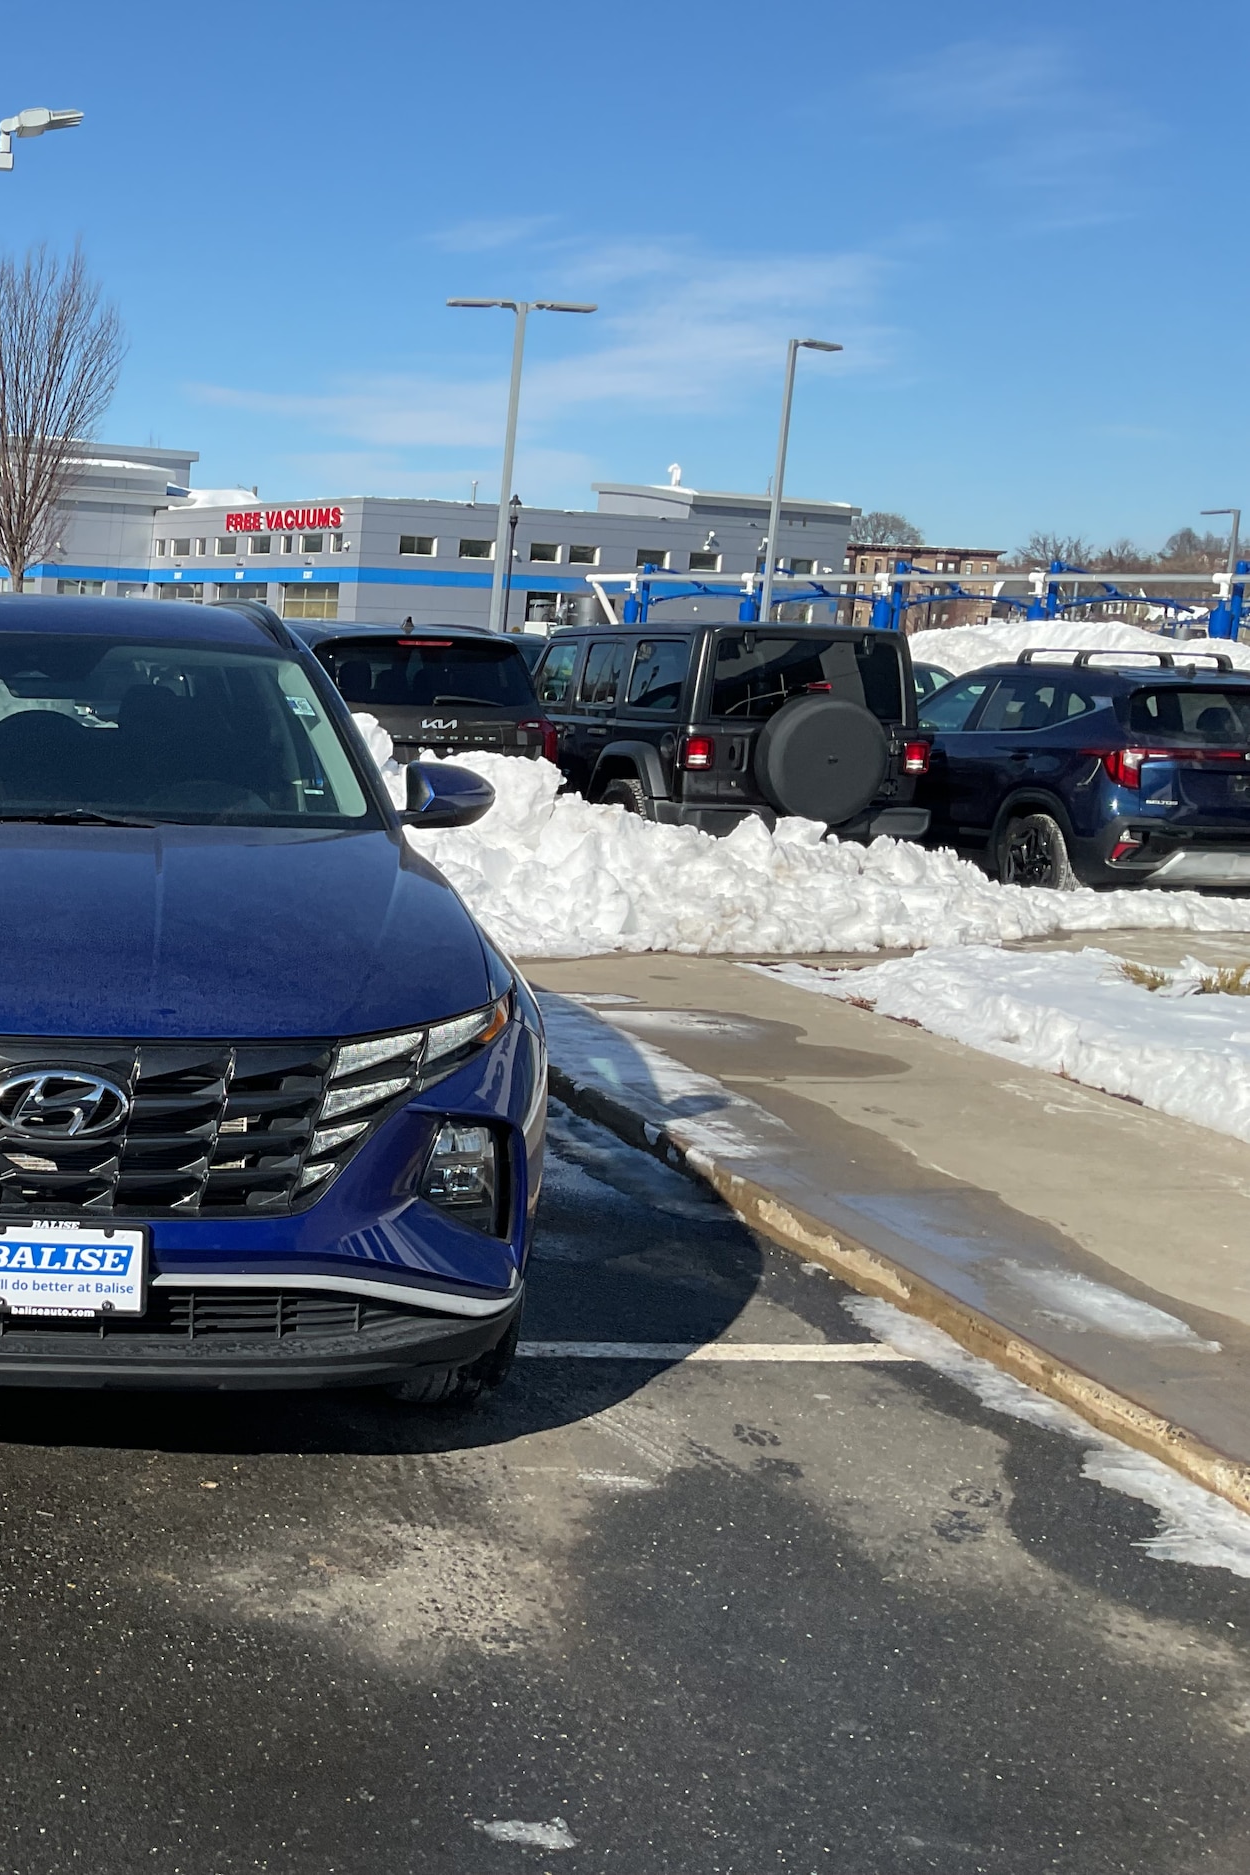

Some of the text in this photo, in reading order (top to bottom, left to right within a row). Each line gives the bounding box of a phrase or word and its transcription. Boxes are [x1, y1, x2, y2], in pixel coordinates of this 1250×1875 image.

[226, 507, 343, 531] FREE VACUUMS
[32, 1220, 80, 1230] BALISE
[11, 1280, 28, 1291] do
[32, 1280, 74, 1292] better
[77, 1283, 91, 1293] at
[95, 1283, 134, 1294] Balise
[11, 1306, 95, 1318] baliseauto.com
